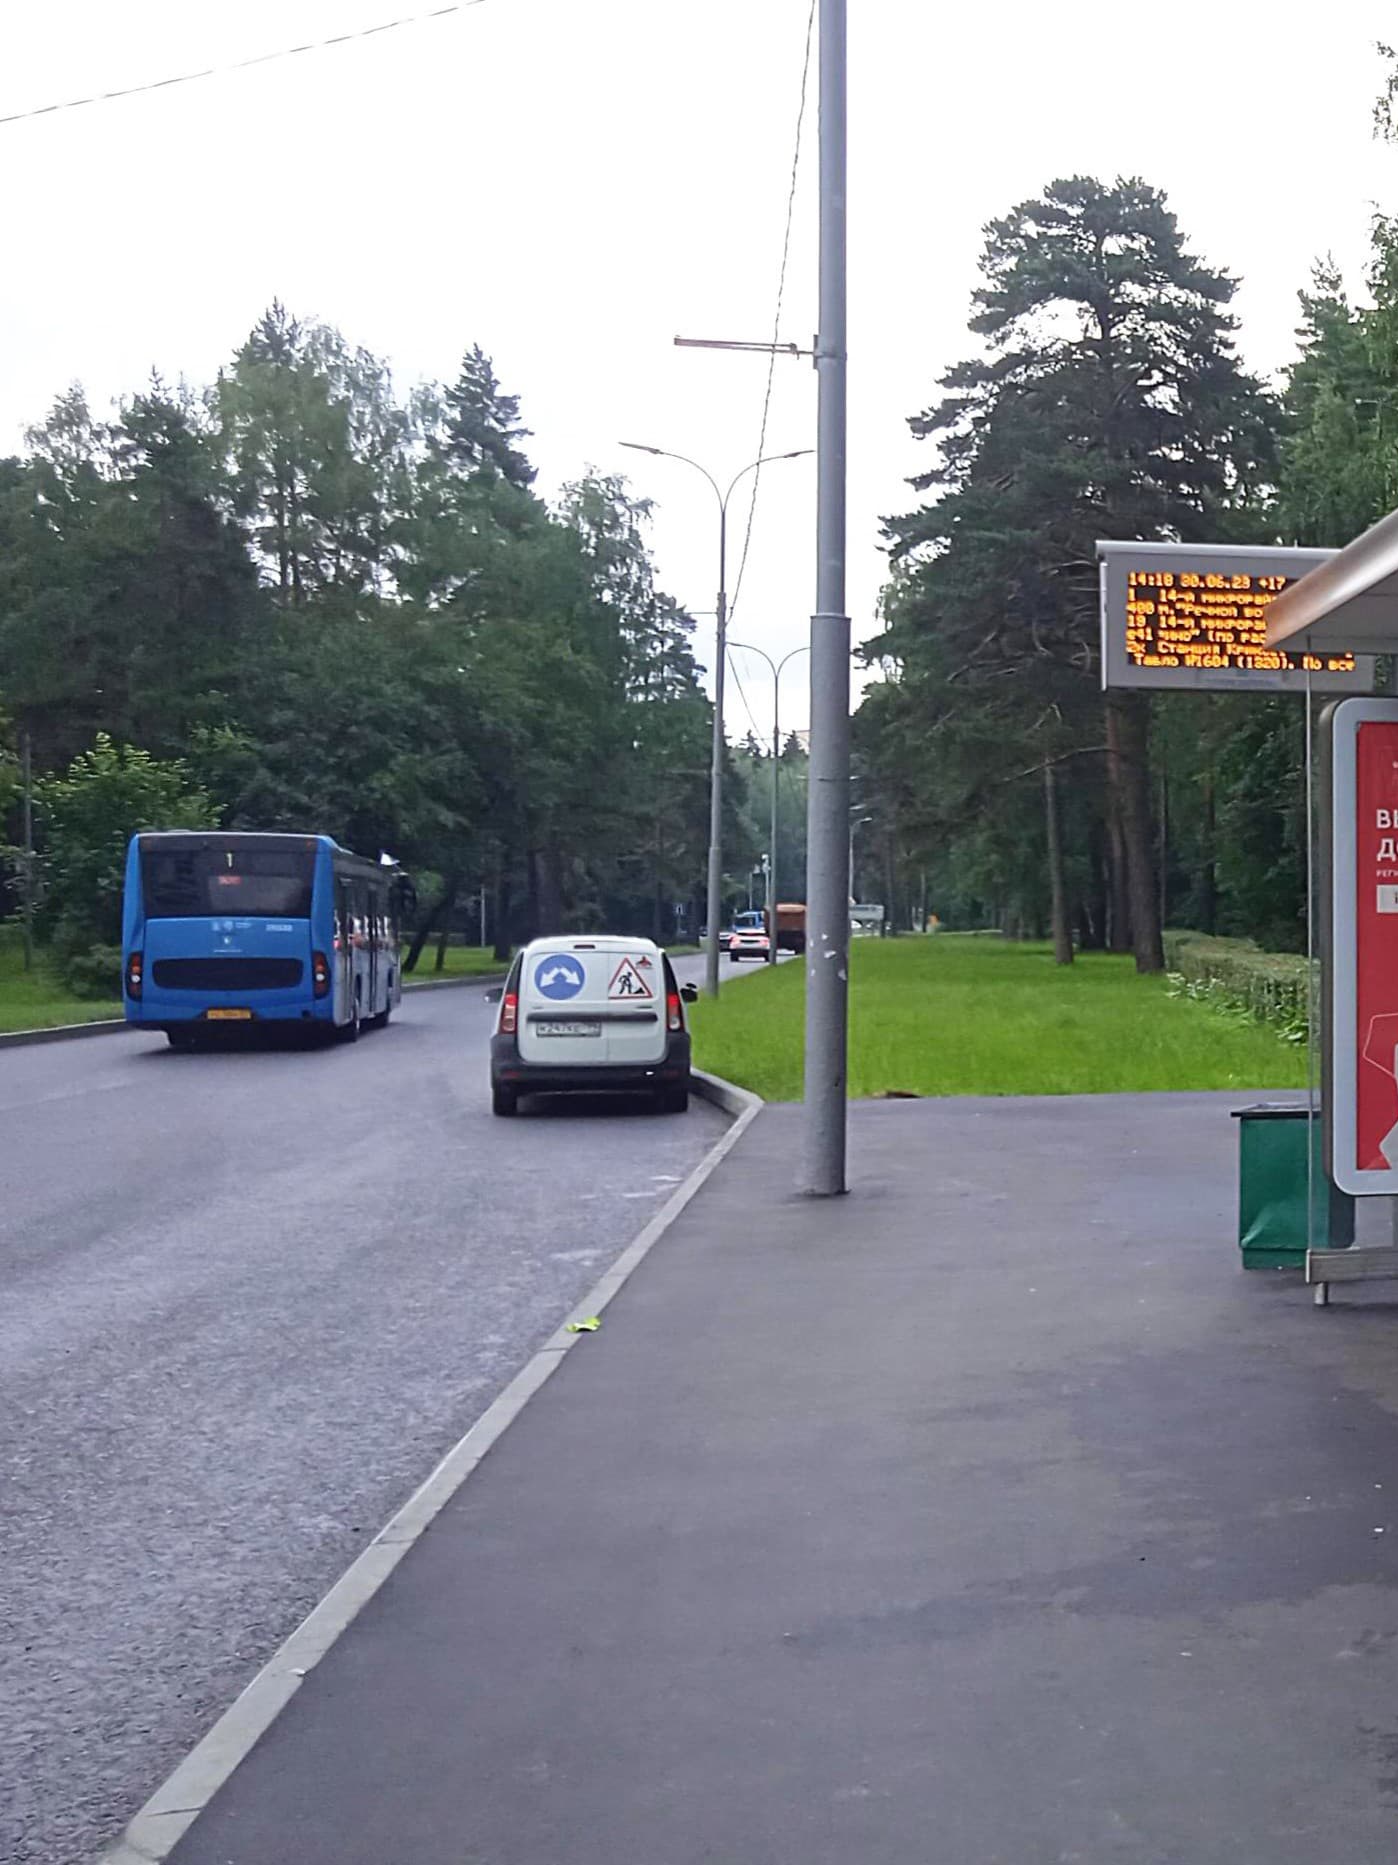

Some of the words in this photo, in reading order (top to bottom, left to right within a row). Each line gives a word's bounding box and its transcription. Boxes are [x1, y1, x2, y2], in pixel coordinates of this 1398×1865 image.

[1129, 571, 1174, 586] 14:18
[1128, 587, 1136, 601] 1
[226, 852, 233, 868] 1
